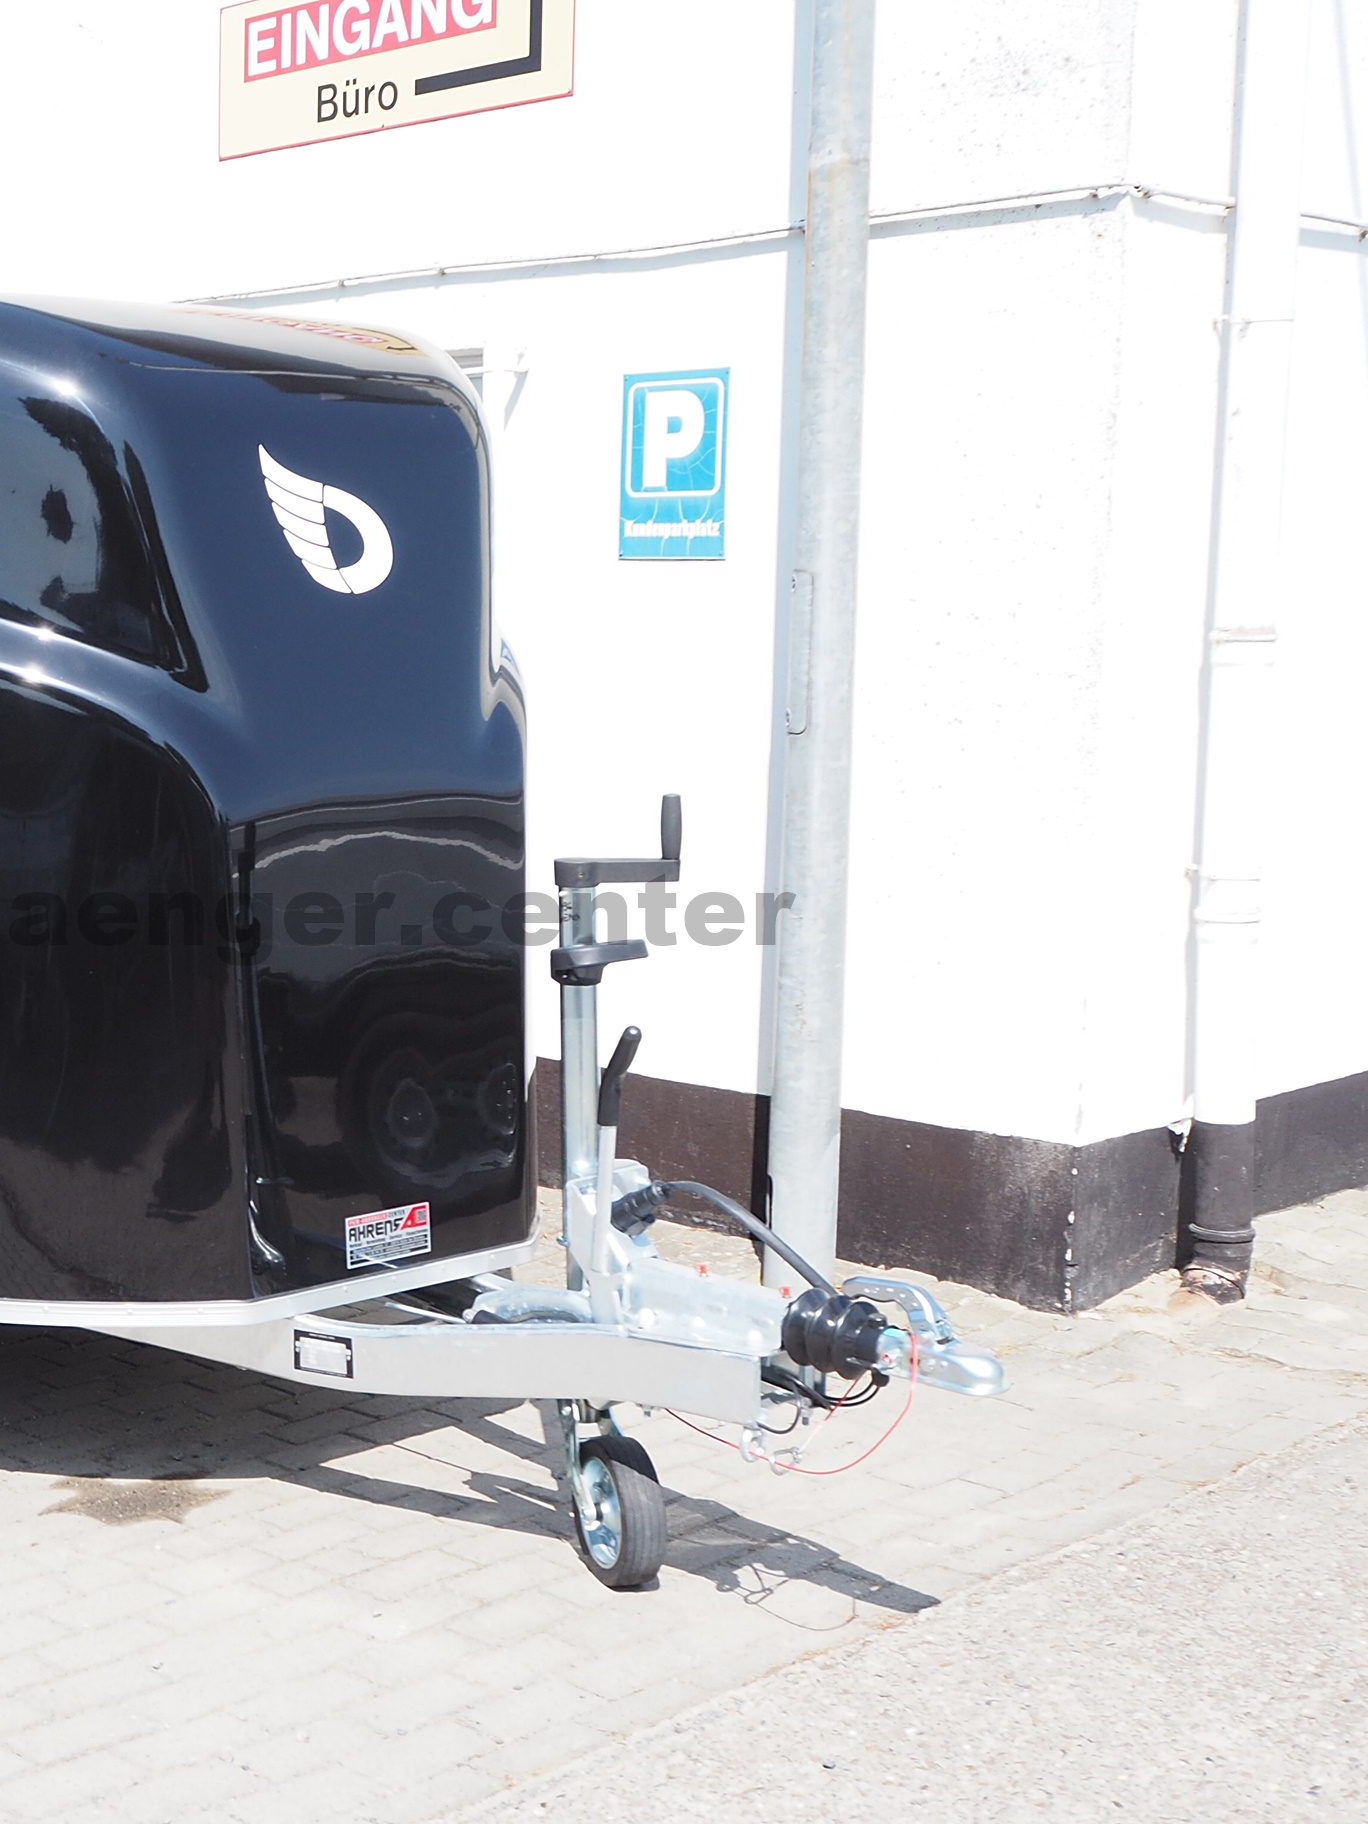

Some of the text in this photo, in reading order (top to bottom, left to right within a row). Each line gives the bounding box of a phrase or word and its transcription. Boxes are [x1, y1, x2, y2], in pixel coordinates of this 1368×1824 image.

[247, 0, 494, 77] EINGANG
[317, 80, 399, 123] Büro
[642, 389, 705, 488] P
[348, 1217, 404, 1242] AHRENS
